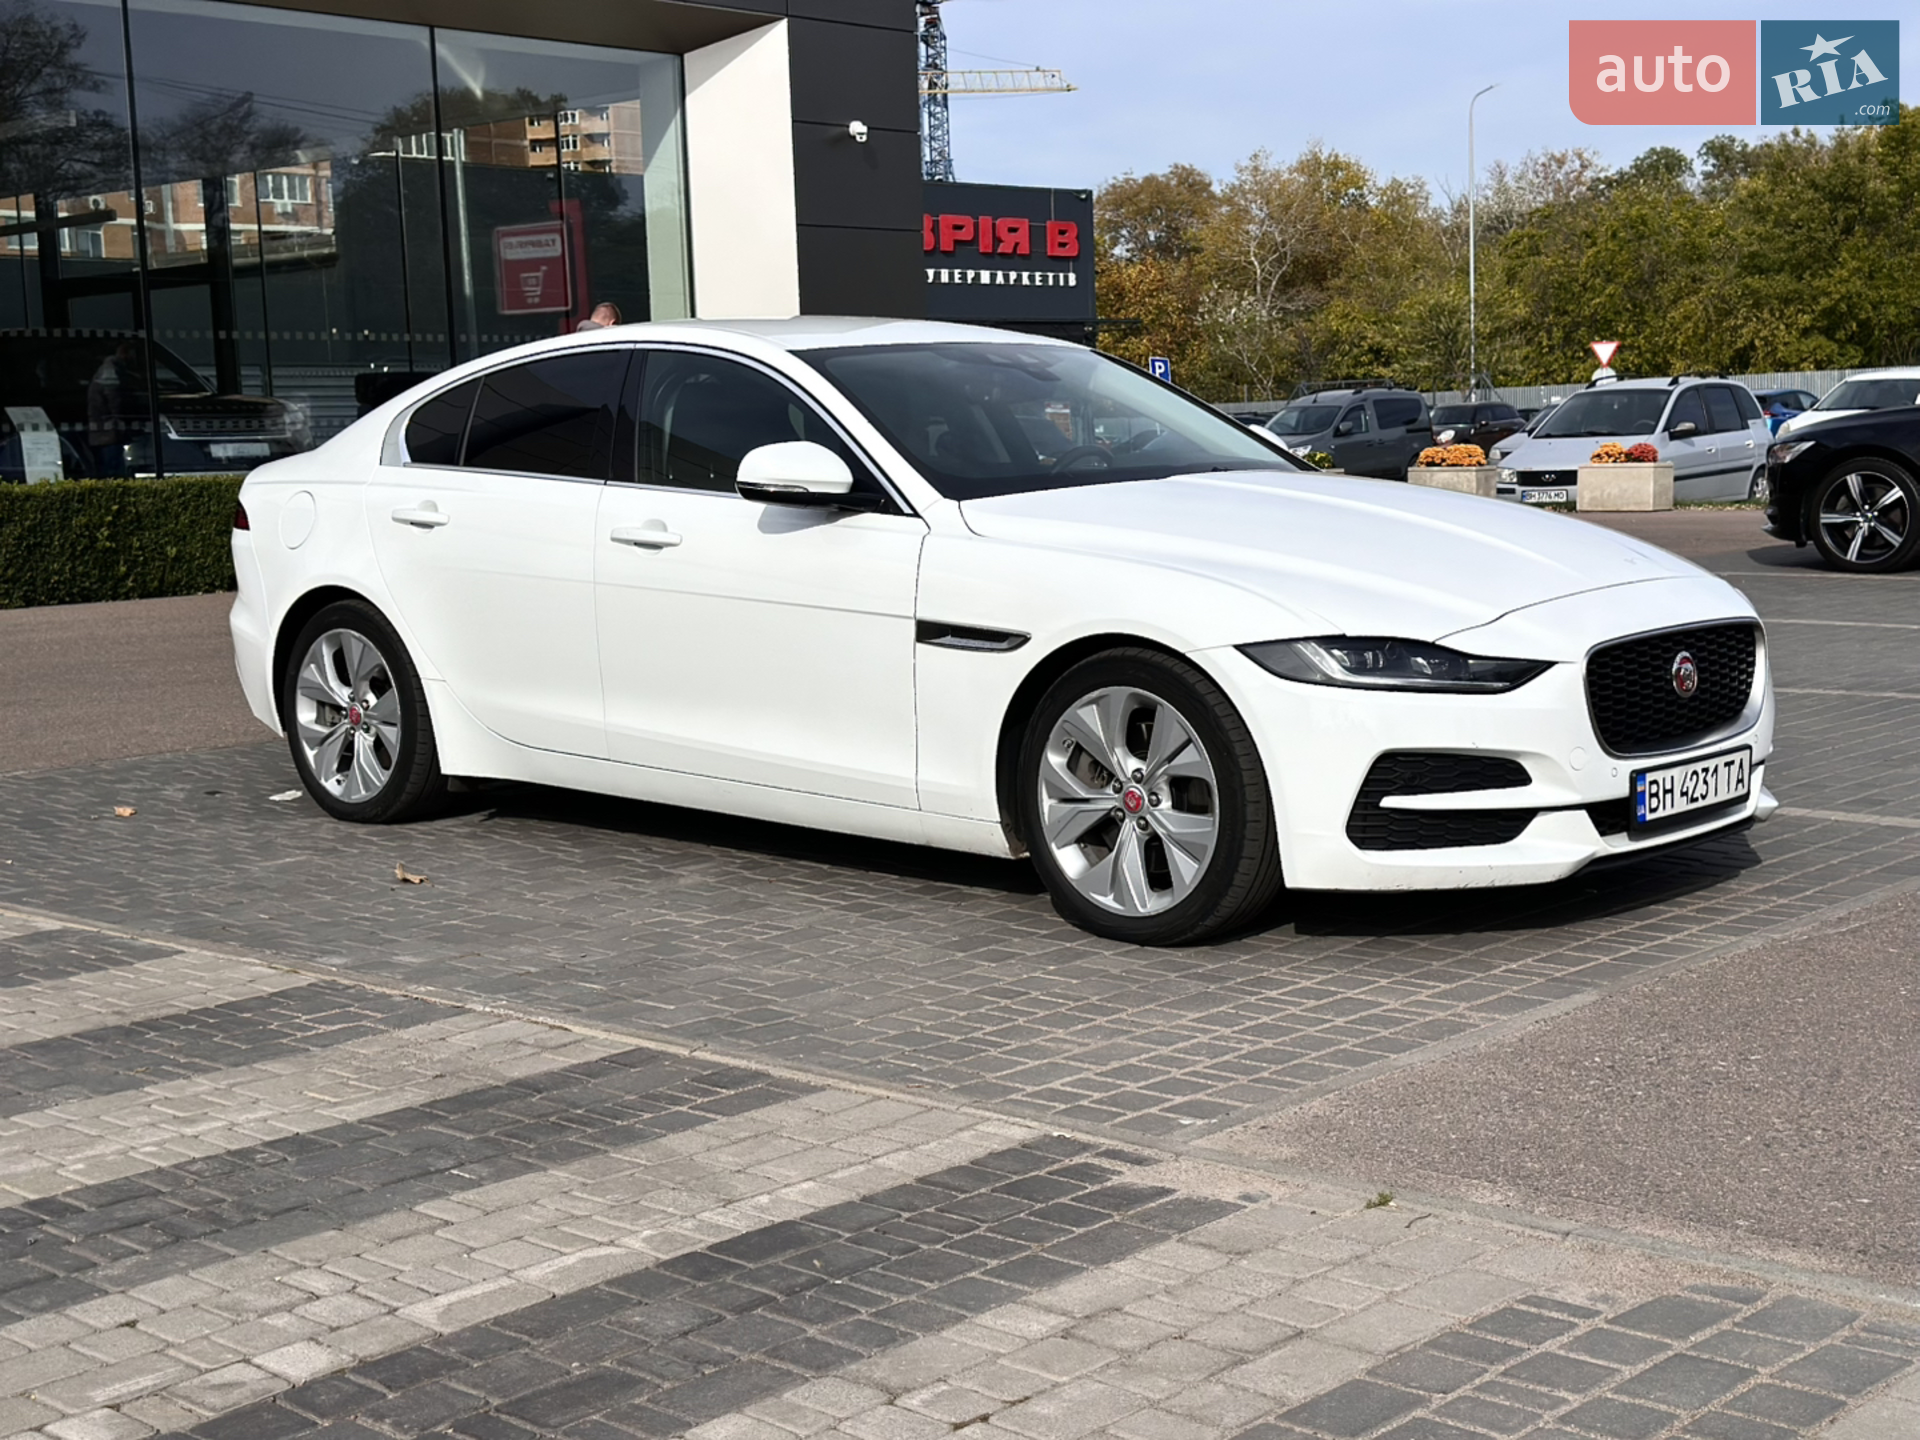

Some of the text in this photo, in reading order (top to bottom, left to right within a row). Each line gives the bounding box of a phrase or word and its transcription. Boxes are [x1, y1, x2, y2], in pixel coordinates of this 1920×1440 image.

[1046, 220, 1080, 258] В
[1154, 361, 1165, 378] P
[1648, 757, 1746, 814] BH 4231 TA
